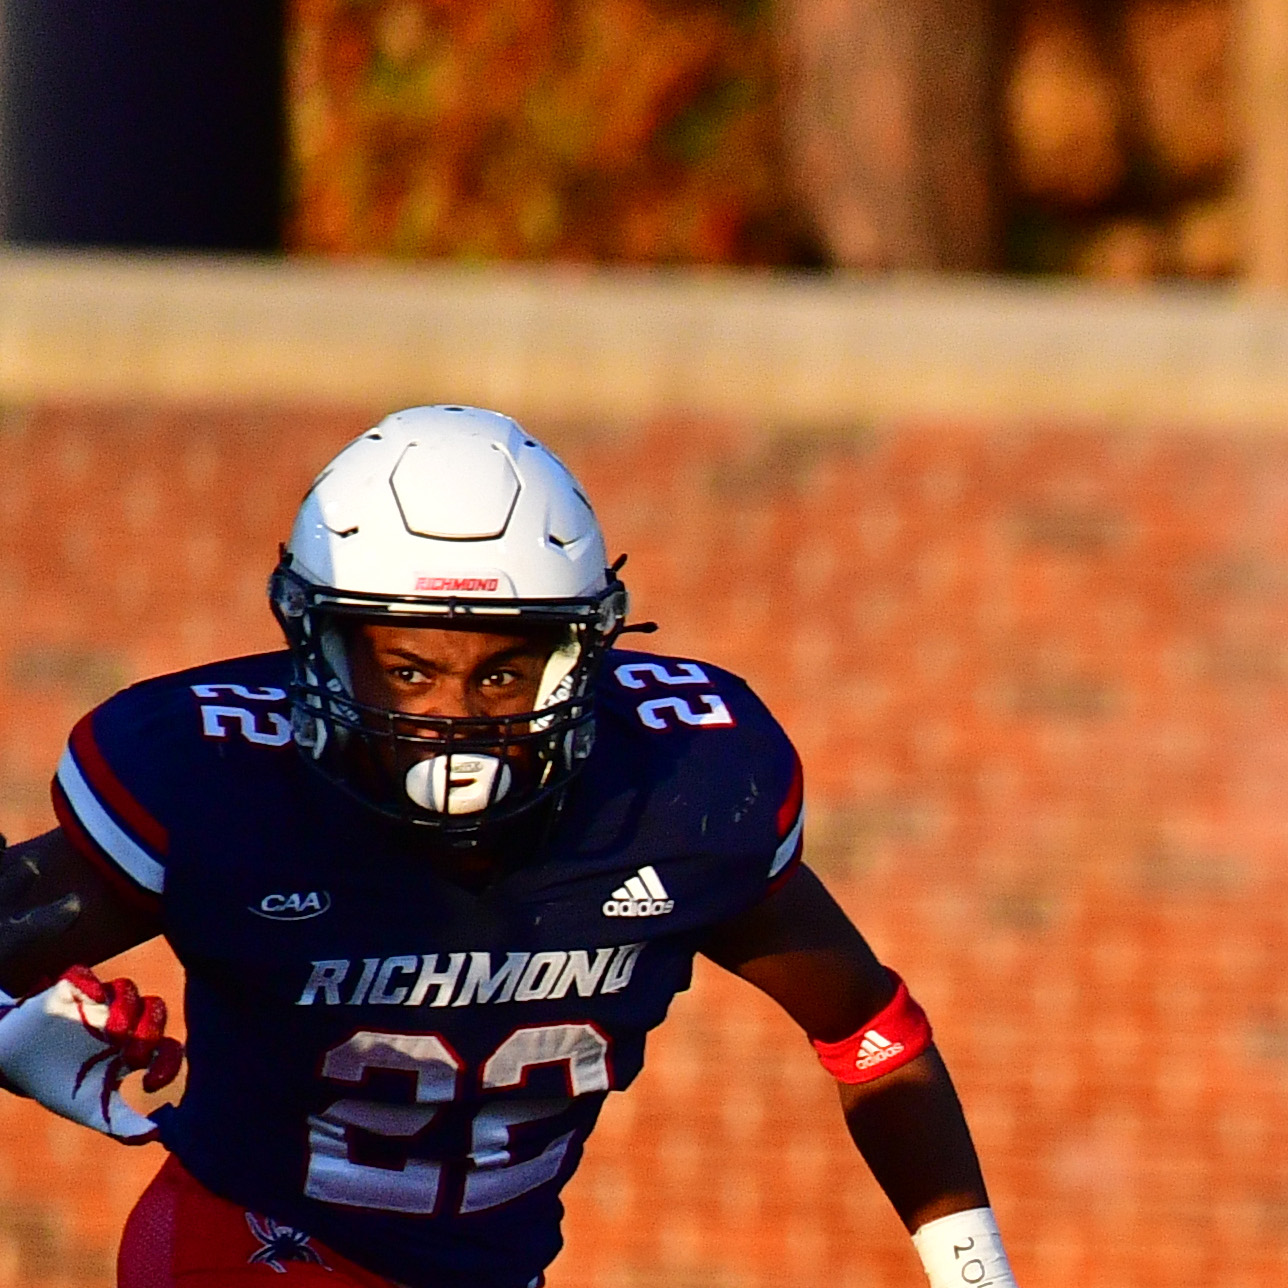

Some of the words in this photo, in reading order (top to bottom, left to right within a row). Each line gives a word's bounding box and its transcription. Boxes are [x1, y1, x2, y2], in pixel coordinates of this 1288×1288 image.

[415, 577, 499, 591] RICHMOND
[189, 683, 293, 747] 22
[613, 662, 736, 731] 22
[261, 891, 321, 912] CAA
[602, 897, 675, 917] adidas
[295, 942, 649, 1007] RICHMOND
[855, 1042, 904, 1070] adidas
[304, 1019, 614, 1217] 22
